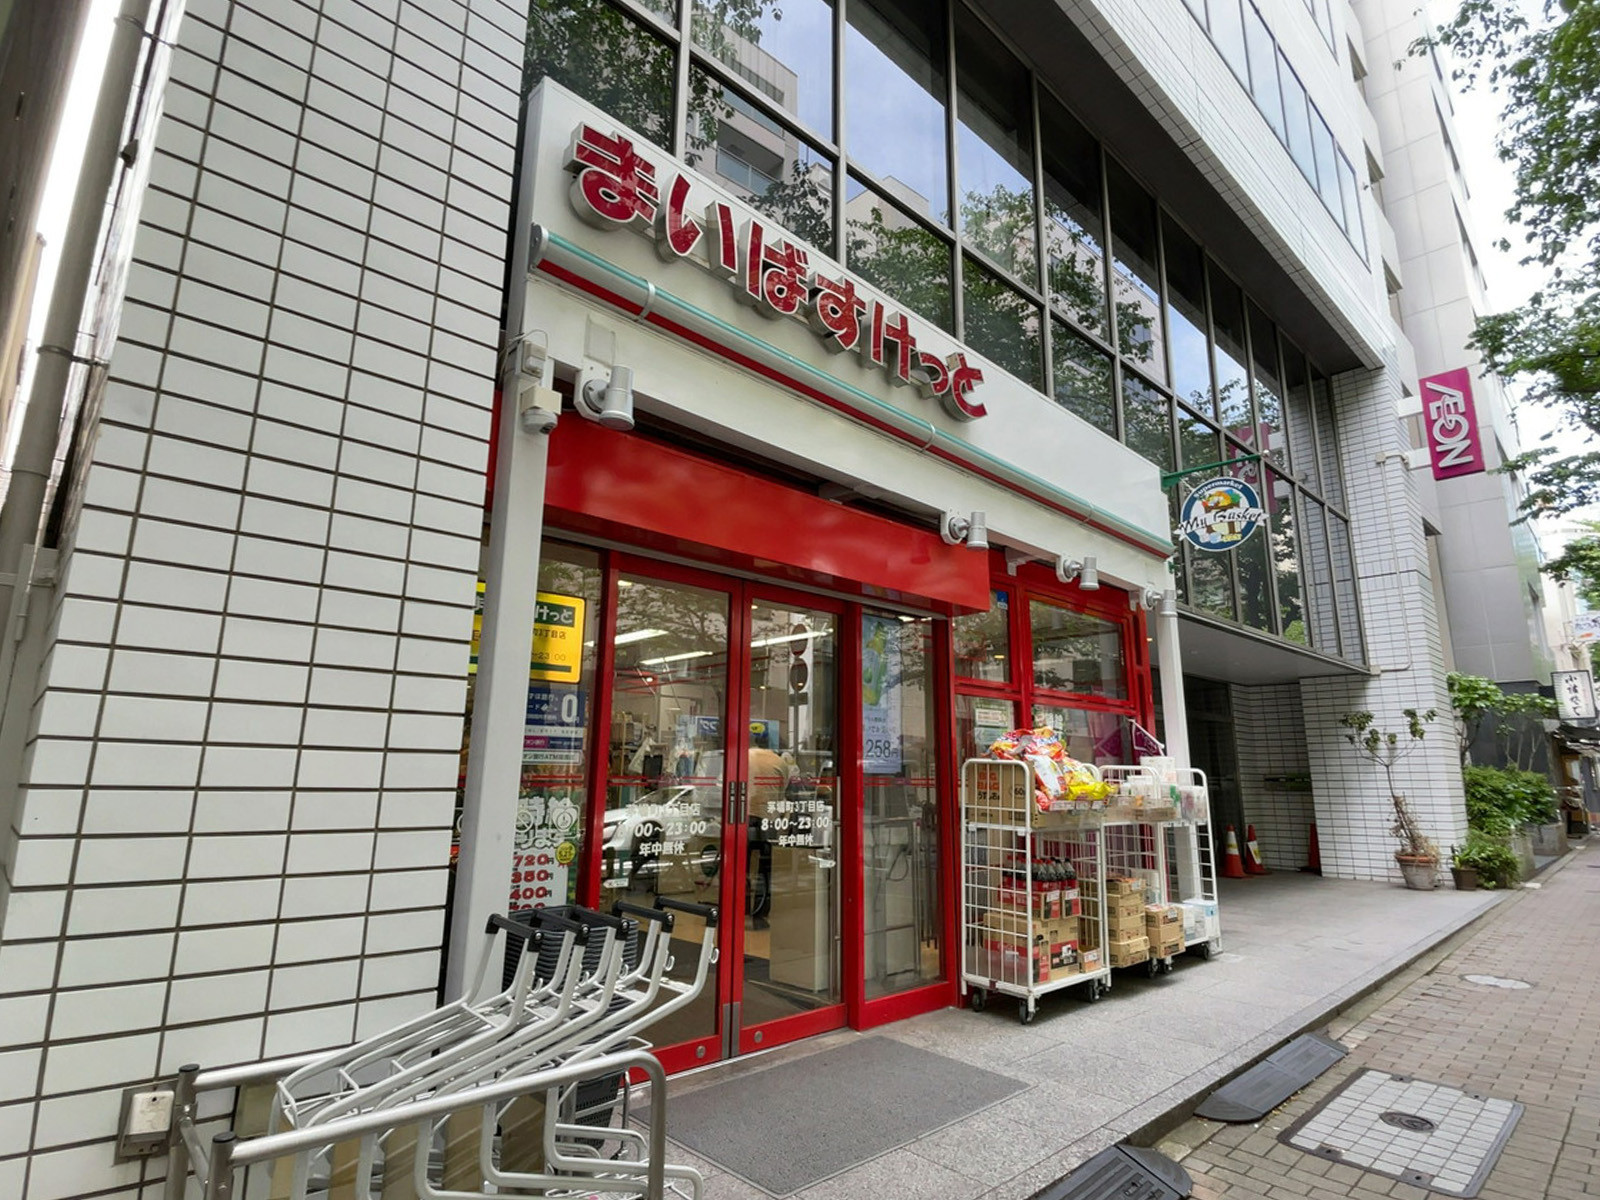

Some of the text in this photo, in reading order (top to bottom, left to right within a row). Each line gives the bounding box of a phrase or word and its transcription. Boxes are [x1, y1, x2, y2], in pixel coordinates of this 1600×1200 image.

[570, 123, 989, 421] まいばすけっと
[1425, 381, 1474, 468] AEON
[1193, 480, 1244, 499] Supermarket
[1179, 507, 1262, 532] My Basket
